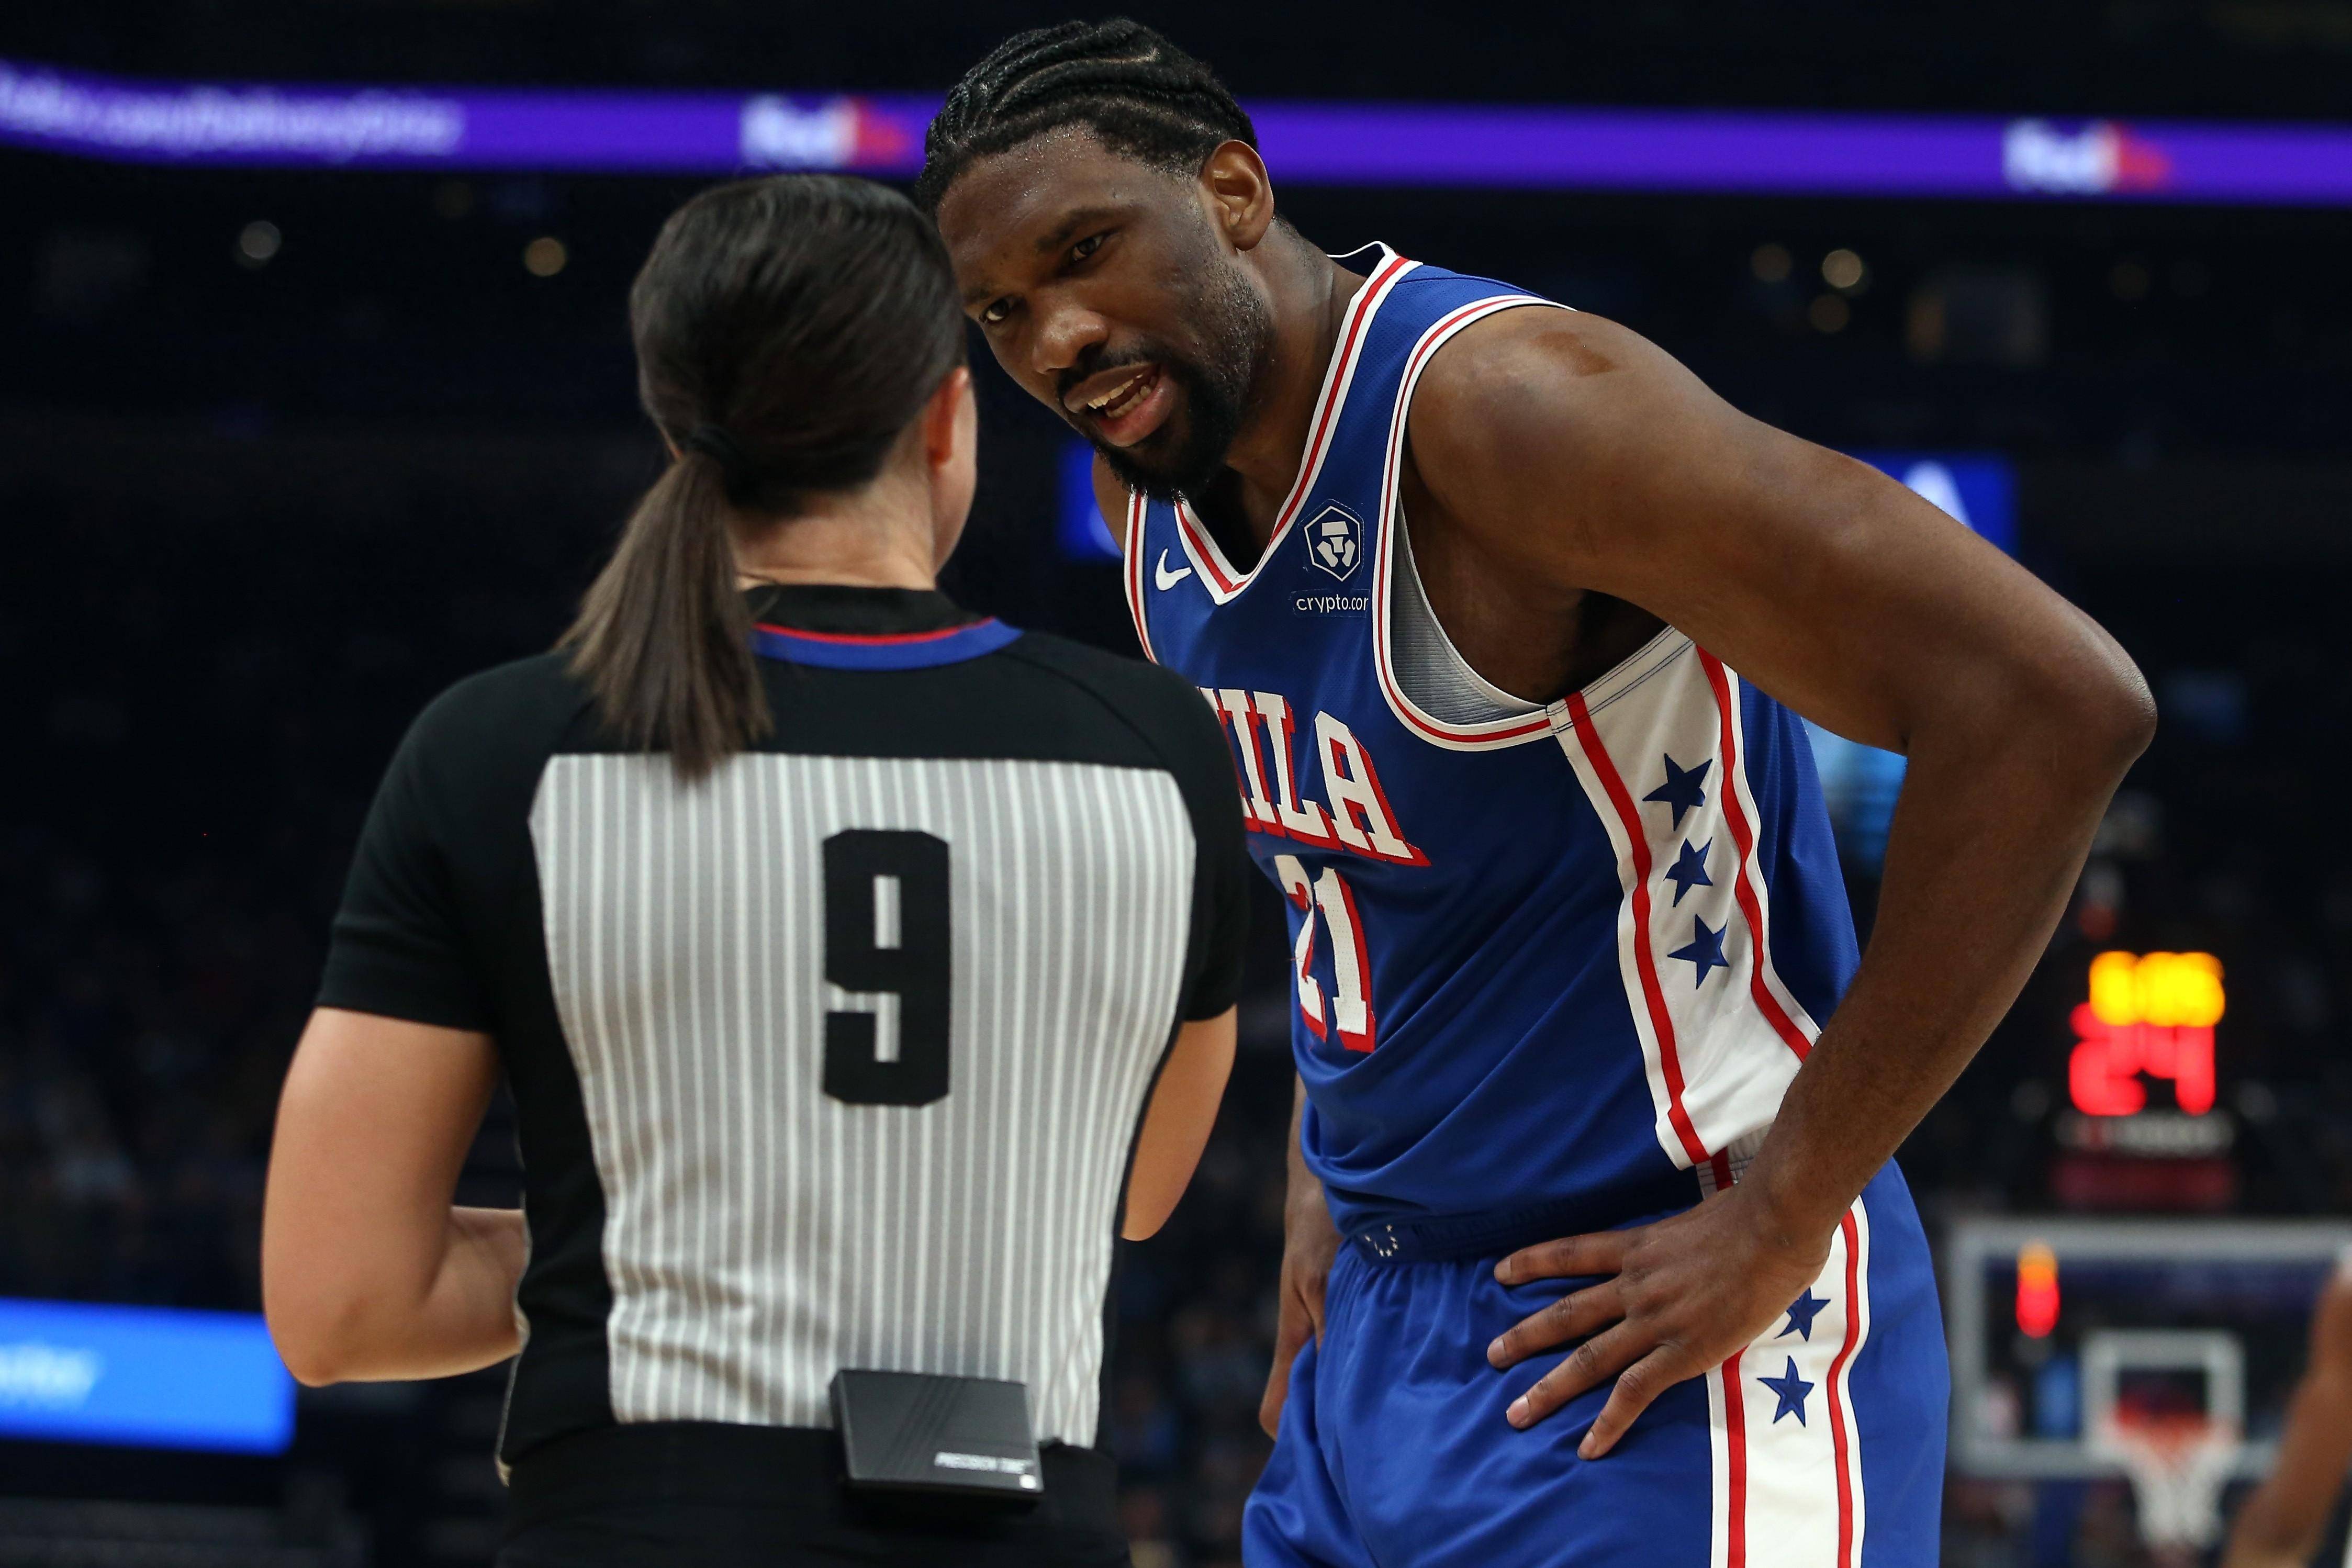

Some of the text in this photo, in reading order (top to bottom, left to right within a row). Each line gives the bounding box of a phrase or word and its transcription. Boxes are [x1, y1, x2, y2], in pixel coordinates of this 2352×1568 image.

[1195, 686, 1431, 867] ILA
[823, 828, 951, 1109] 9
[1274, 855, 1376, 1053] 21
